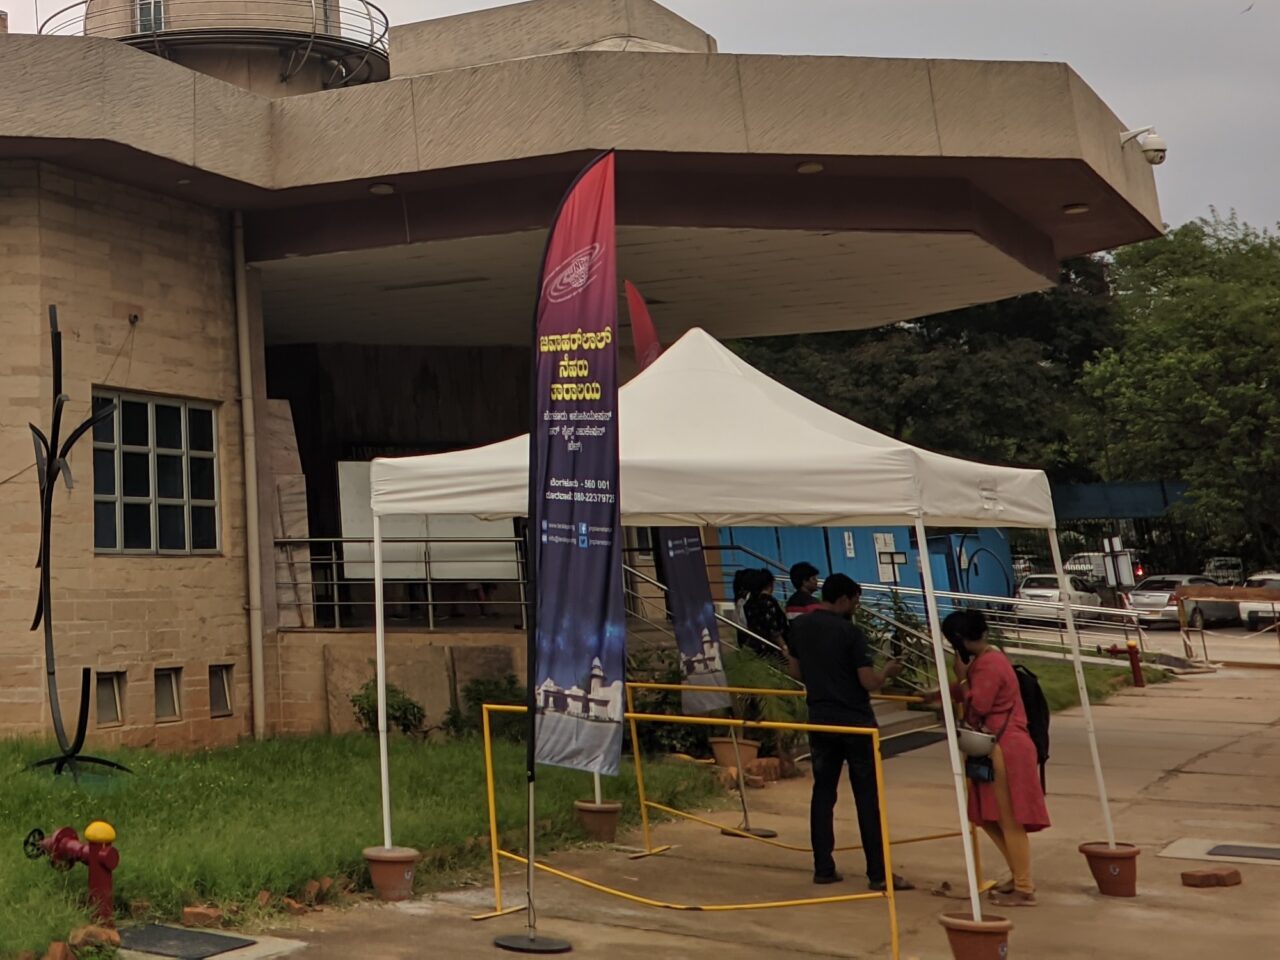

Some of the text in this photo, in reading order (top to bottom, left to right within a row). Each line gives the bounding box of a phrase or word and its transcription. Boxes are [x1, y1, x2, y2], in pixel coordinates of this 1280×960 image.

[559, 353, 589, 378] ನೆಹರು
[550, 382, 601, 401] ತಾರಾಲಯ
[584, 479, 596, 488] 560
[597, 480, 610, 490] 001
